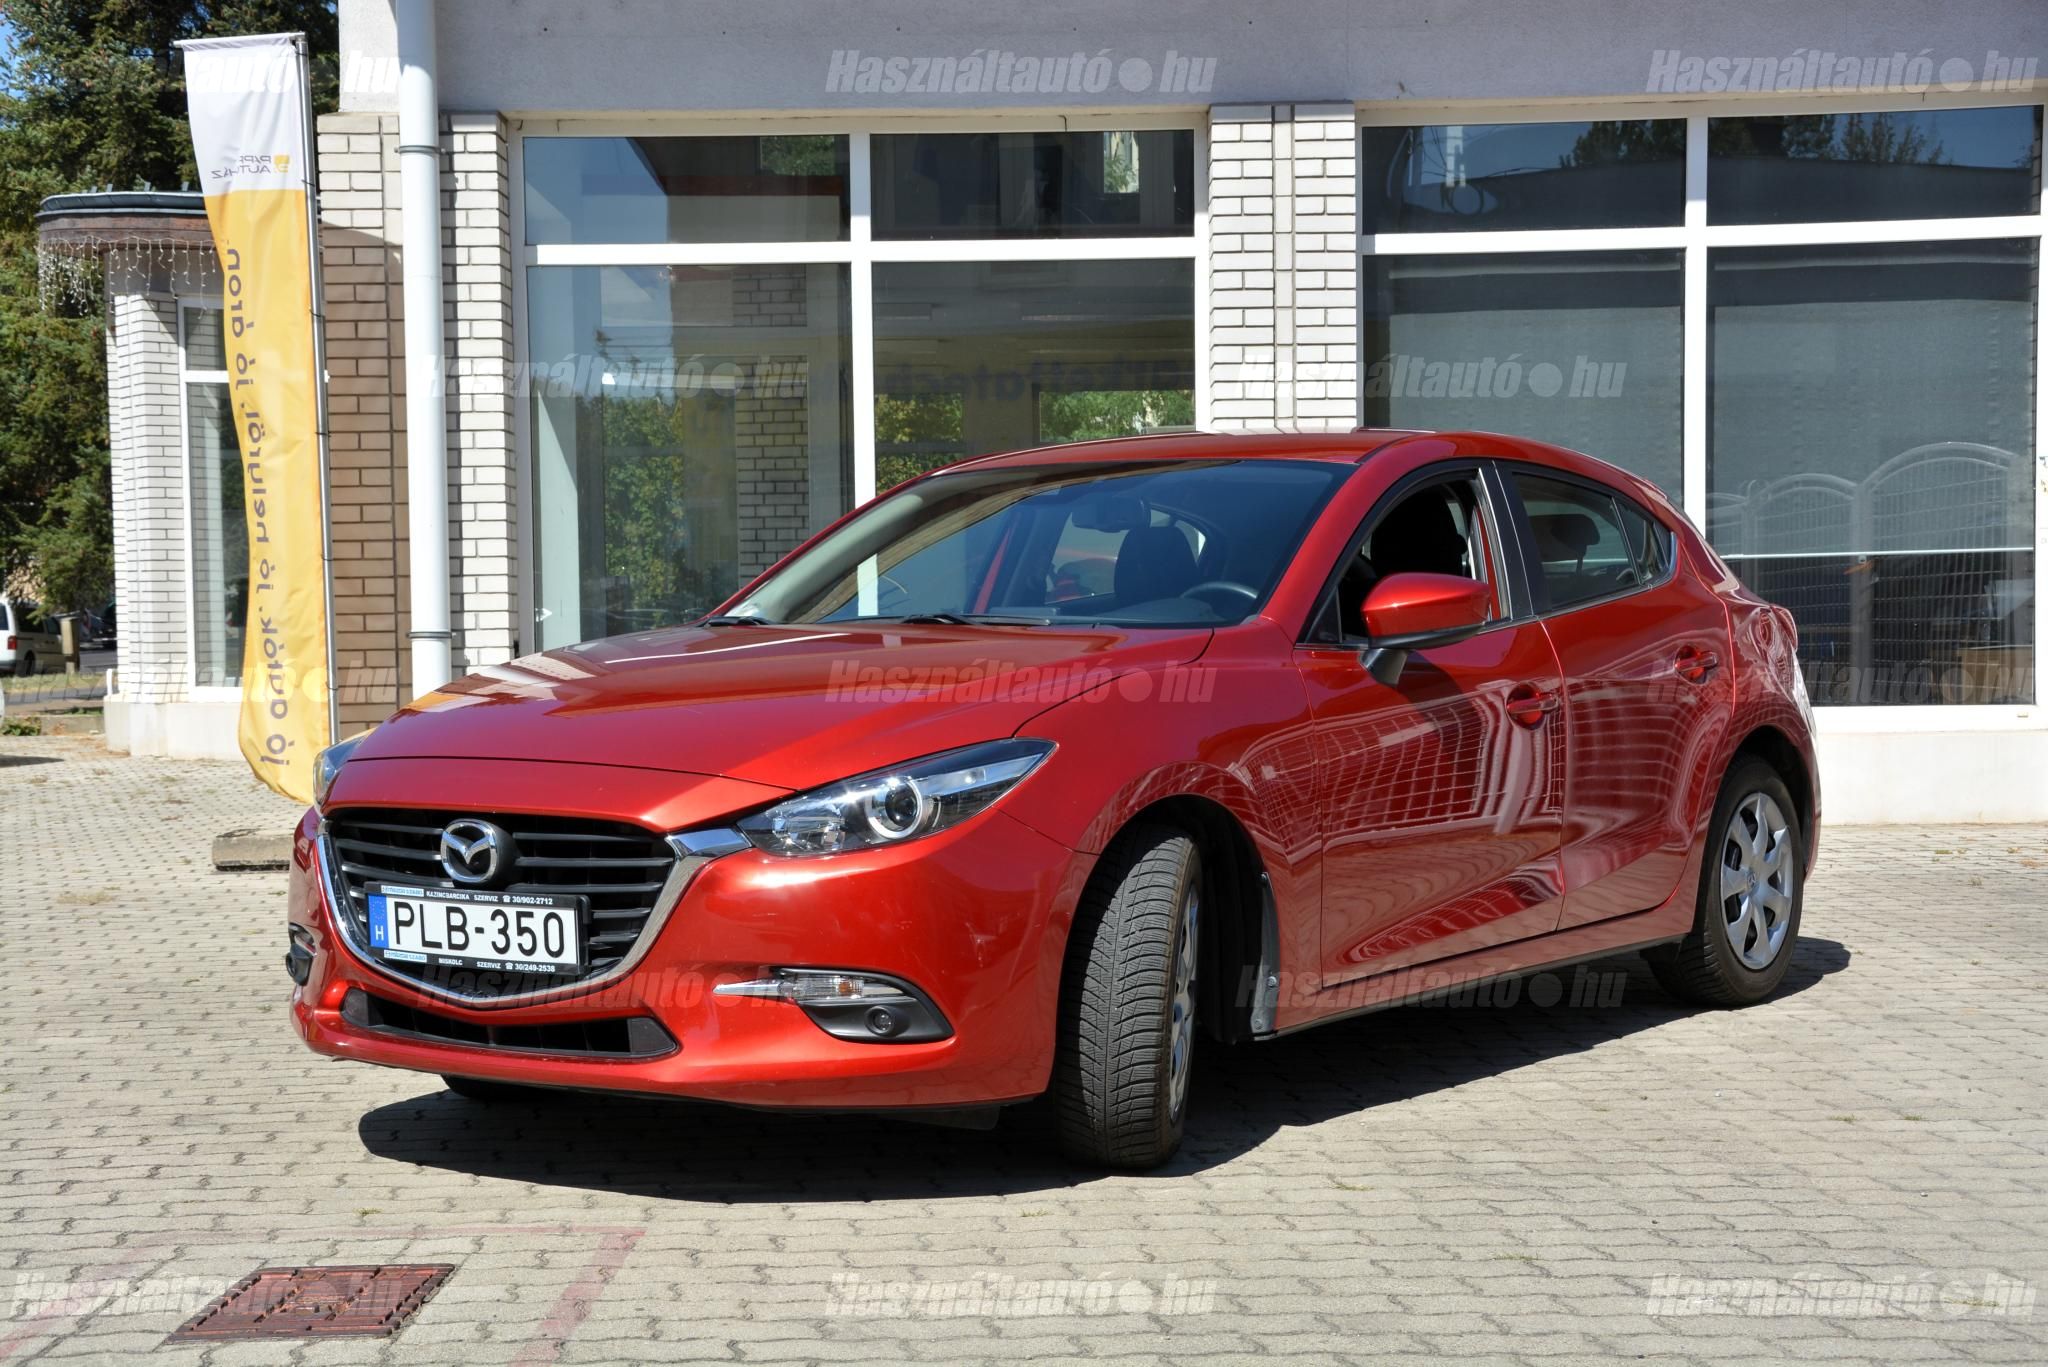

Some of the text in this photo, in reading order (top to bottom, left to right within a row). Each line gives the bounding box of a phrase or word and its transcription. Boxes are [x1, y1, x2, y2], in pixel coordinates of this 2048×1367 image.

[473, 894, 499, 902] SZERVIZ
[375, 900, 565, 958] H PLB-350
[476, 961, 502, 969] SZERVIZ
